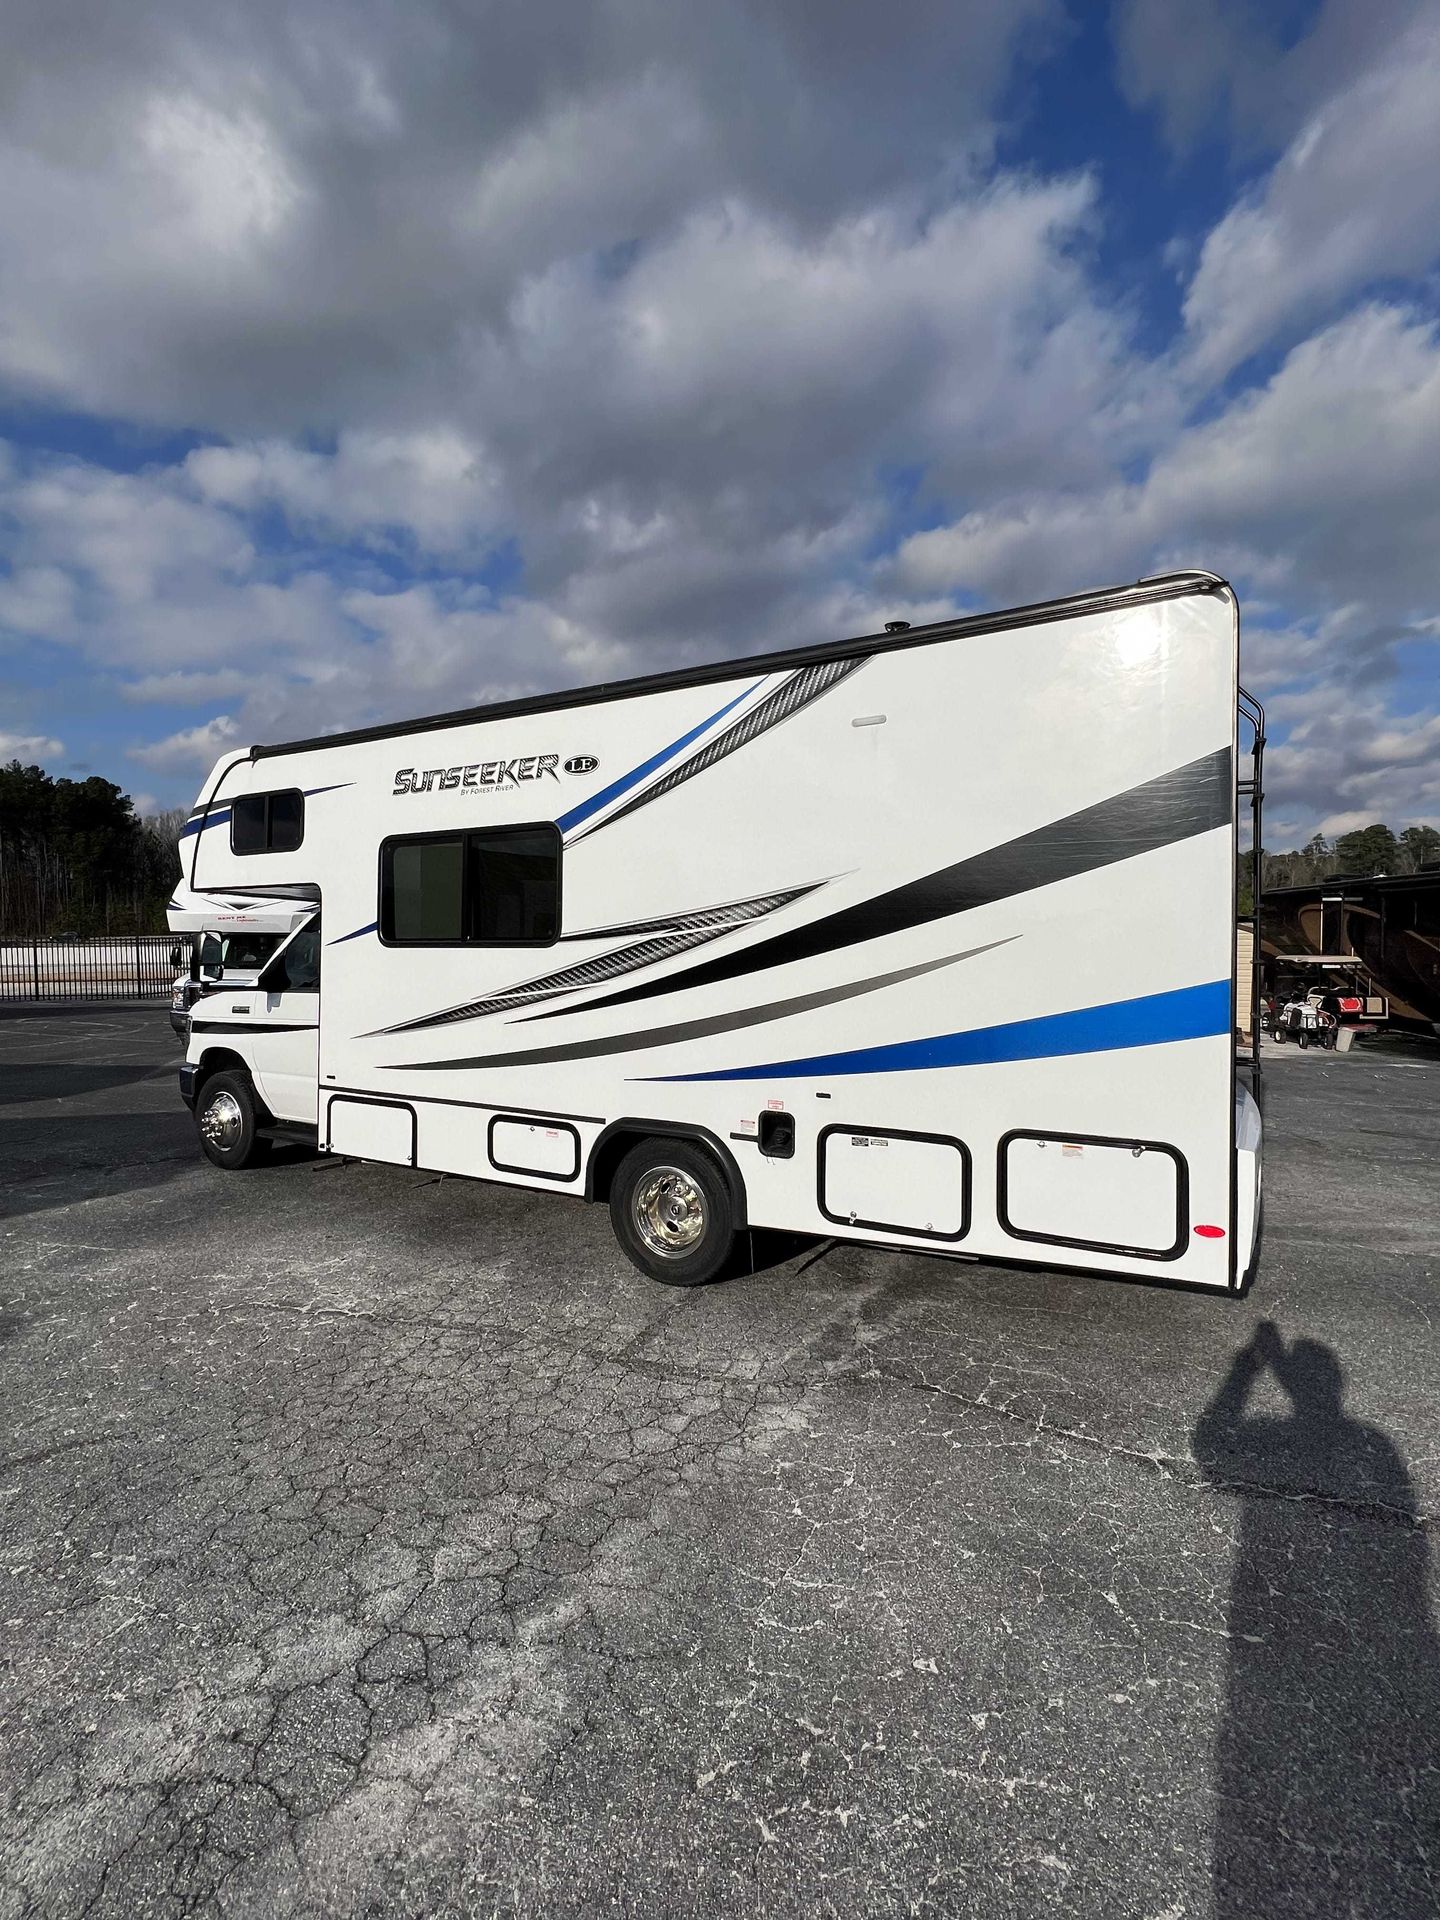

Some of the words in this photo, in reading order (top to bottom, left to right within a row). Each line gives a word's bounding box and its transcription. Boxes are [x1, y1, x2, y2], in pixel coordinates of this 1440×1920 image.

[392, 754, 560, 795] SUNSEEKER
[569, 757, 594, 772] LE
[460, 788, 470, 796] BY
[470, 786, 494, 795] FOREST
[495, 784, 514, 792] RIVER
